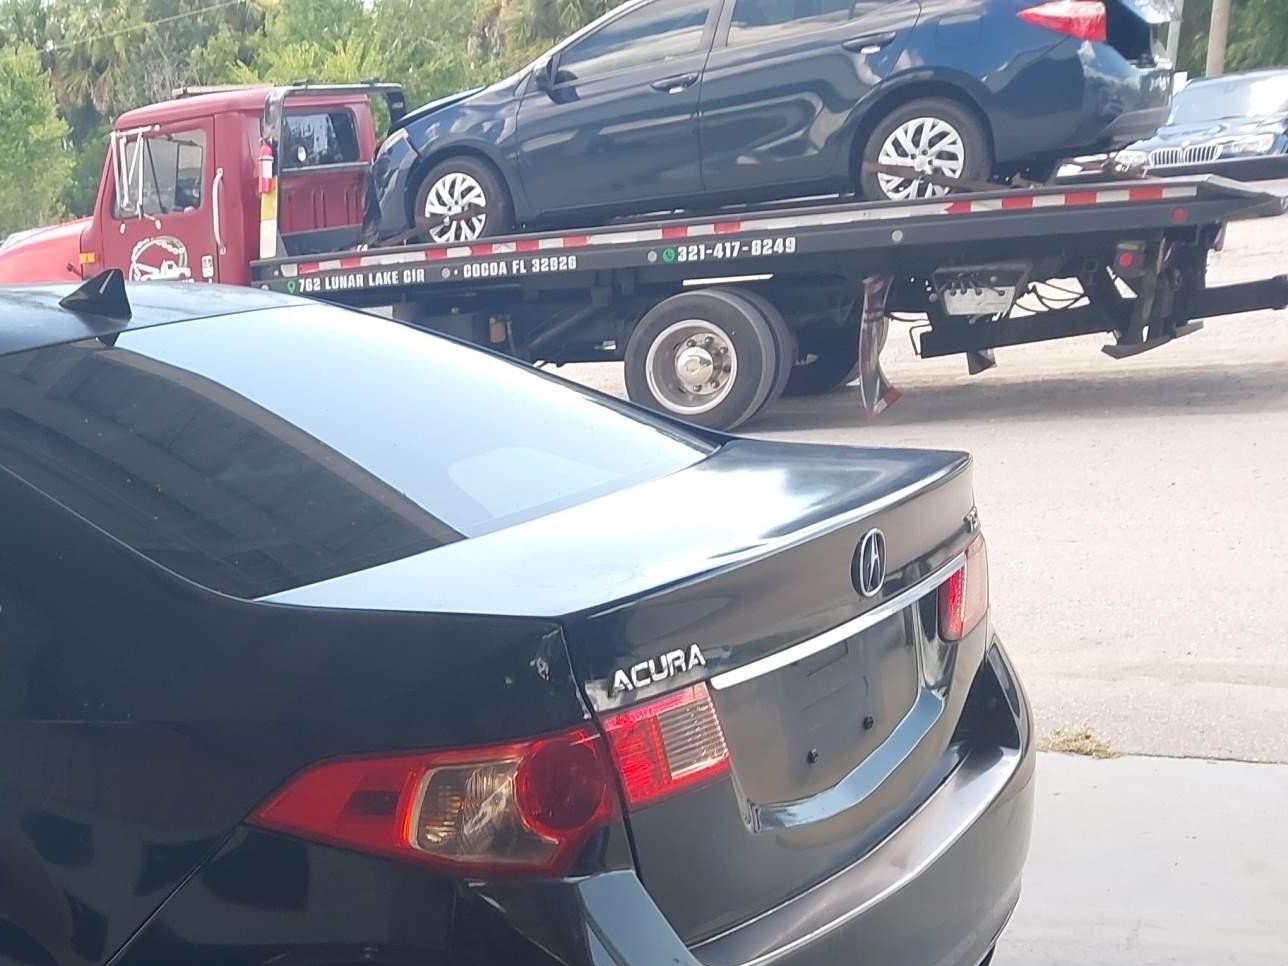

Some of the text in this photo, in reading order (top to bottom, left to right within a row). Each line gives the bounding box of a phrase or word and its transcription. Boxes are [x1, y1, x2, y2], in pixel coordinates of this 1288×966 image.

[677, 237, 796, 262] 321-417-8249
[298, 278, 321, 292] 762
[325, 273, 364, 290] LUNAR
[368, 270, 398, 286] LAKE
[403, 268, 425, 283] CIR
[463, 261, 507, 278] COCOA
[512, 259, 527, 274] FL
[613, 643, 706, 691] ACURA
